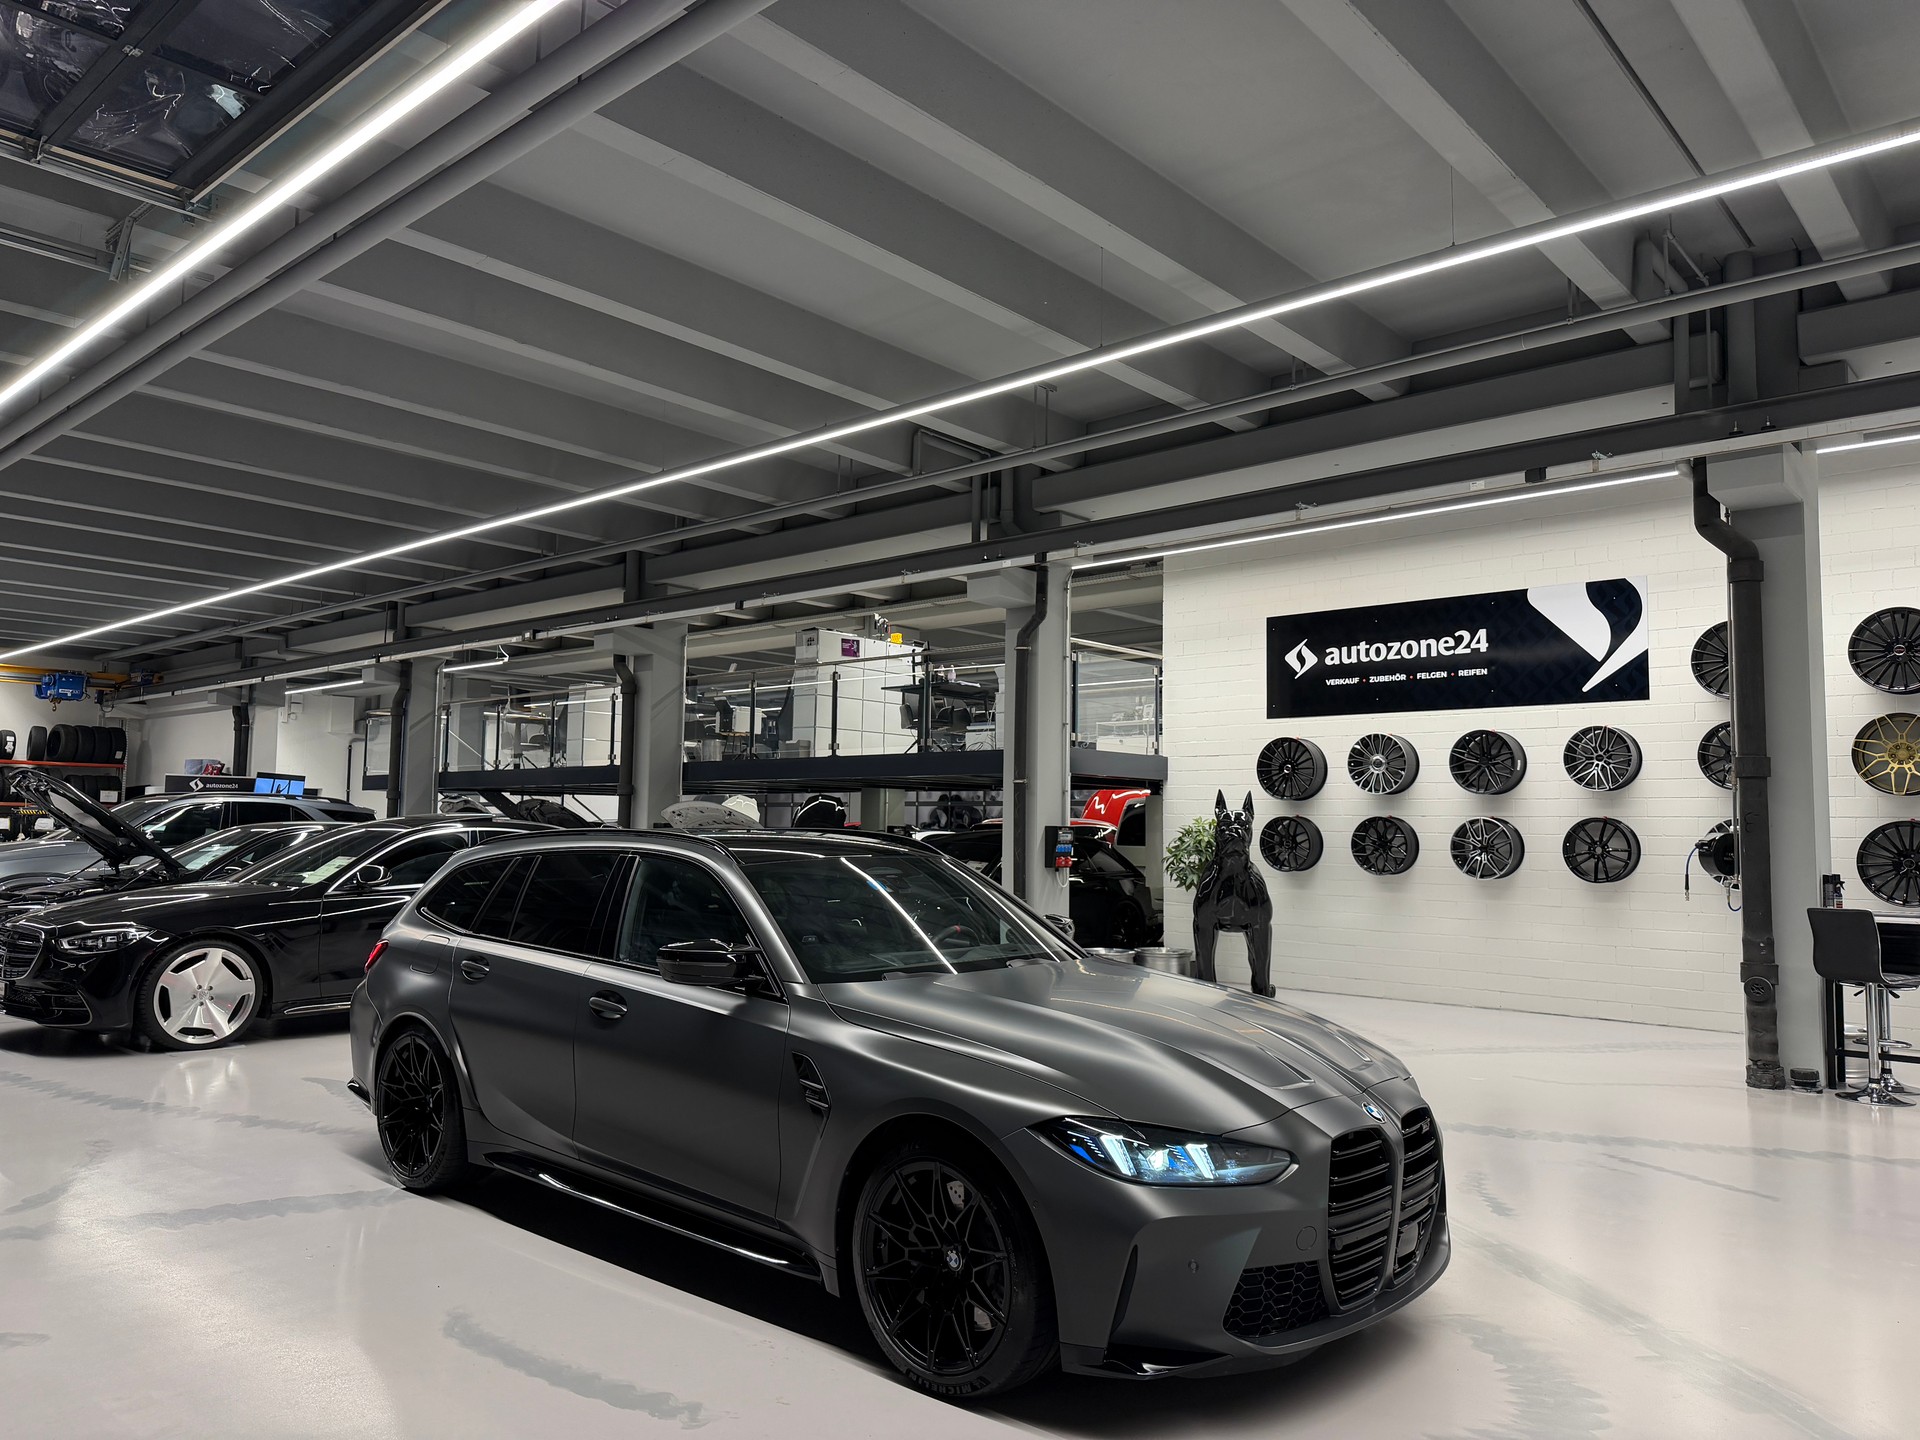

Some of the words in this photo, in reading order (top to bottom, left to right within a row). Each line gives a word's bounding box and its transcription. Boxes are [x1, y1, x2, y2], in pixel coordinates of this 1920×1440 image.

[1324, 628, 1489, 666] autozone24
[1325, 677, 1360, 686] VERKAUF
[1368, 673, 1407, 683] ZUBEHÖR
[1416, 670, 1448, 680] FELGEN
[1457, 668, 1488, 677] REIFEN
[205, 782, 239, 790] autozone24
